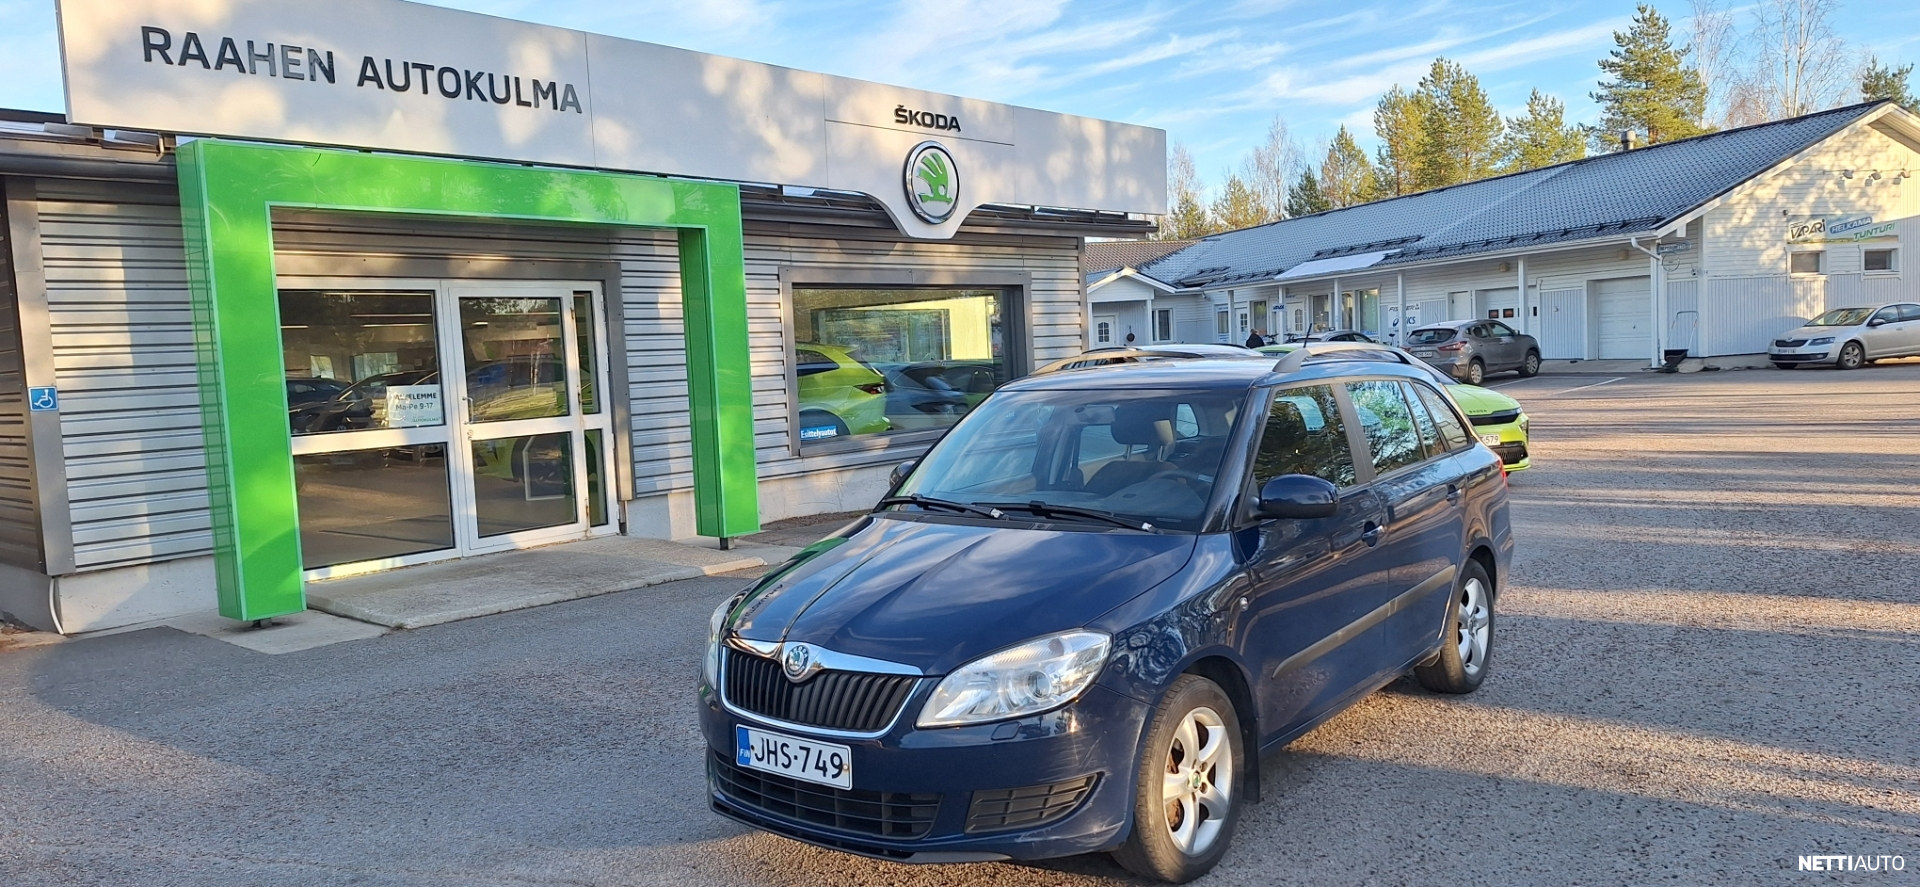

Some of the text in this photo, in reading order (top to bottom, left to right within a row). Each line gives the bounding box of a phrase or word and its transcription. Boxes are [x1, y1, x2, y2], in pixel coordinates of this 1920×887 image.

[141, 25, 583, 114] RAAHEN AUTOKULMA
[894, 104, 962, 132] ŠKODA
[1831, 217, 1872, 233] HELKAMA
[1852, 222, 1896, 241] TUNTURI
[754, 737, 843, 779] JHS-749
